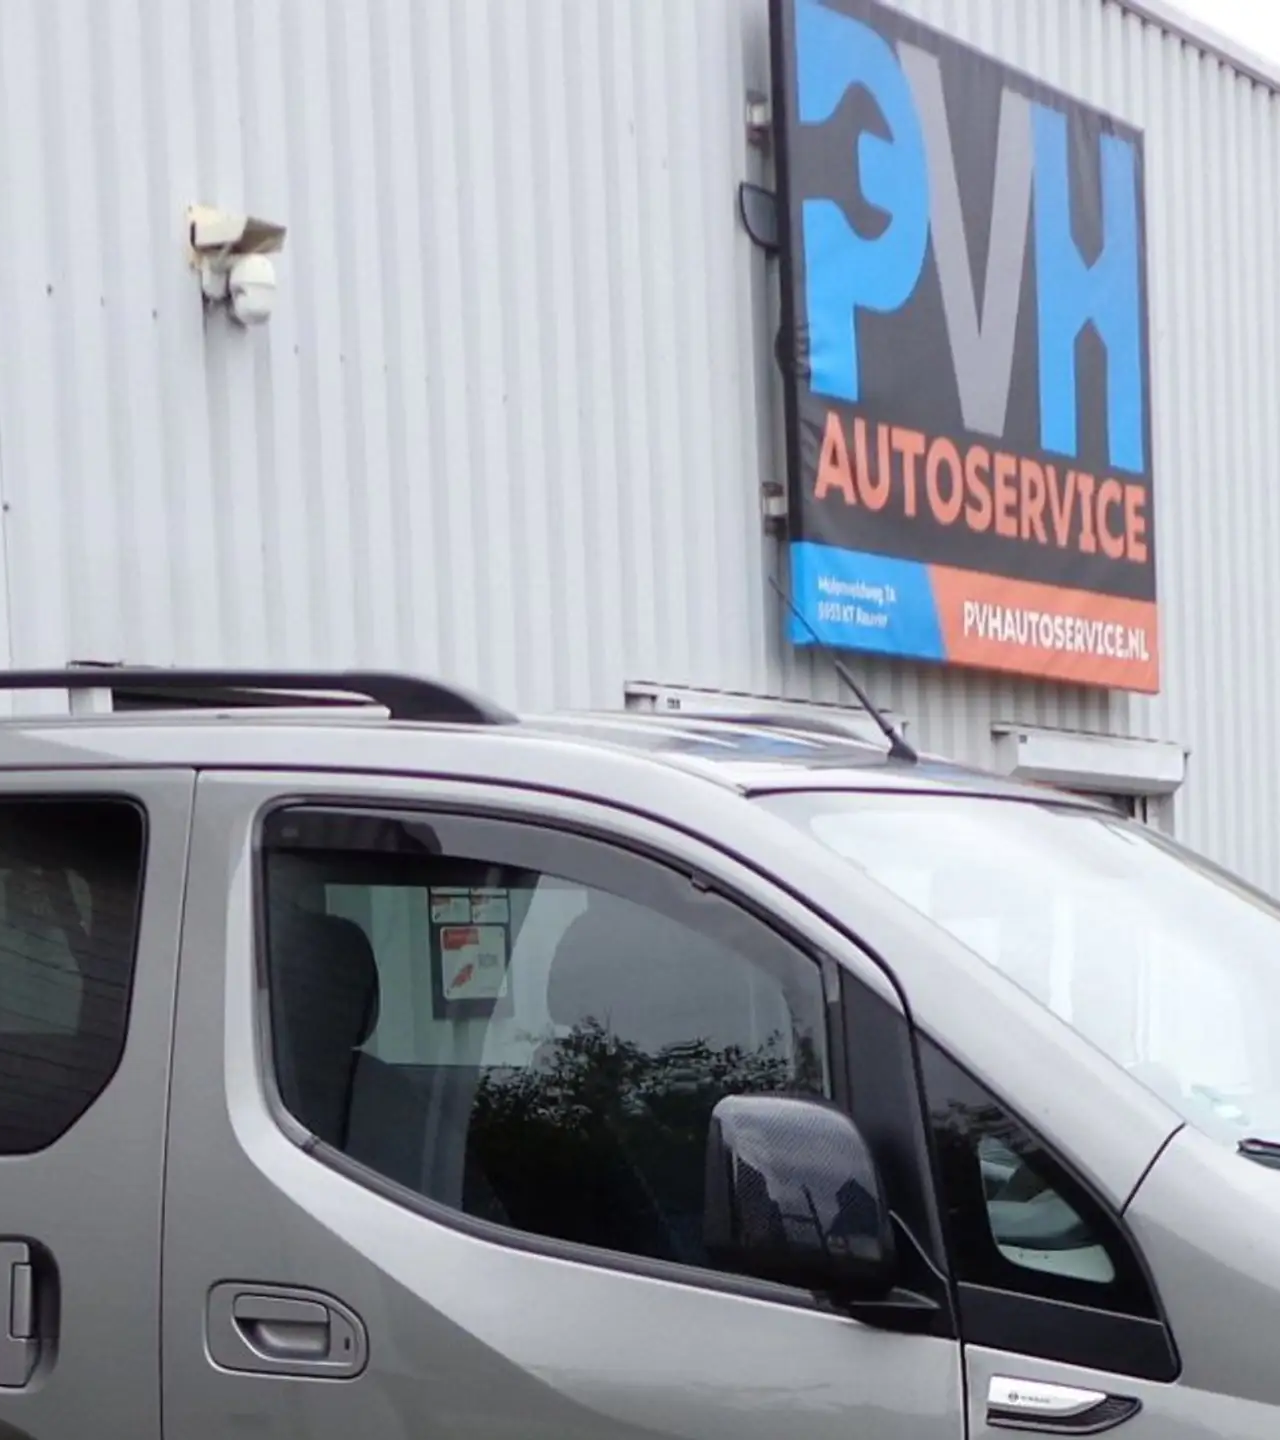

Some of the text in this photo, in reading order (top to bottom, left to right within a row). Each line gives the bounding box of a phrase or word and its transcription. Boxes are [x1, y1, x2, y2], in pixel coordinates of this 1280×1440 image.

[795, 2, 1145, 473] PVH
[814, 410, 1148, 562] AUTOSERVICE
[963, 600, 1150, 661] PVHAUTOSERVICE.NL
